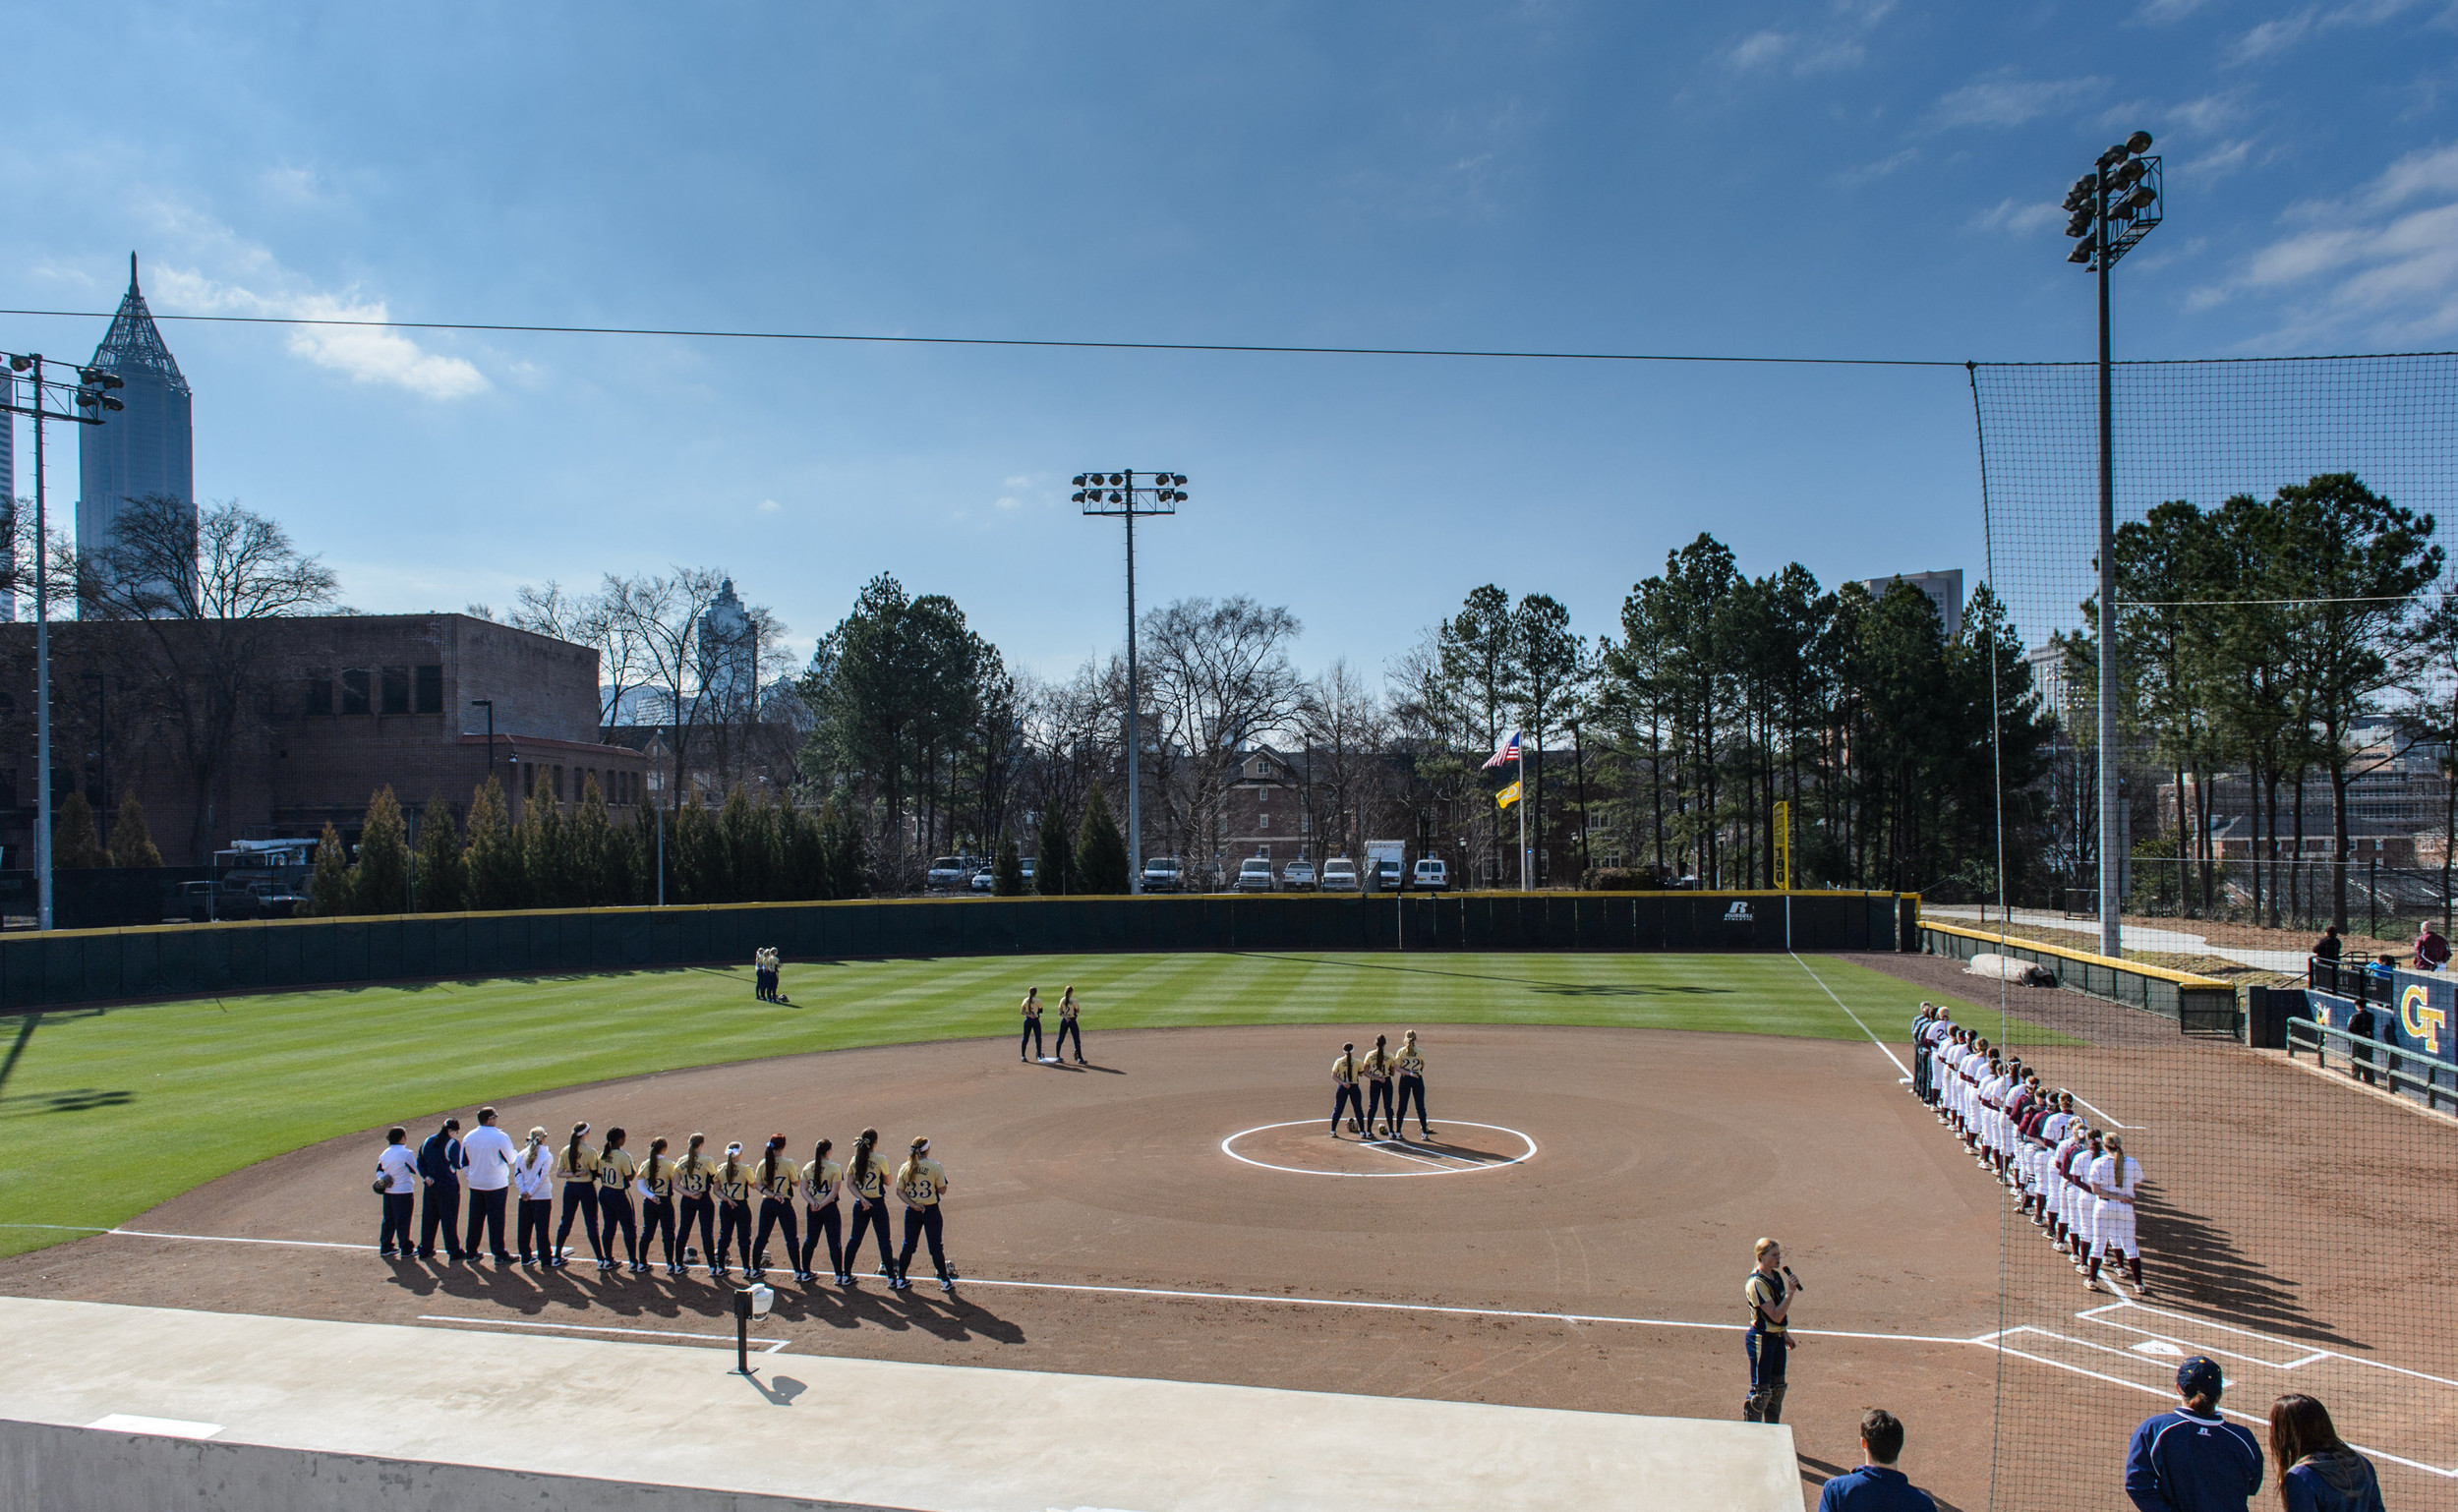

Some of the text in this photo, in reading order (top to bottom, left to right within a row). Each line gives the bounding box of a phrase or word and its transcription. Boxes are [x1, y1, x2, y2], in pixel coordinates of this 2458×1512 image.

[1776, 846, 1785, 882] 190
[2401, 984, 2446, 1054] GT
[1402, 1058, 1421, 1073] 22
[603, 1166, 617, 1185] 10
[683, 1173, 703, 1192] 13
[724, 1182, 742, 1199] 17
[906, 1180, 933, 1198] 33
